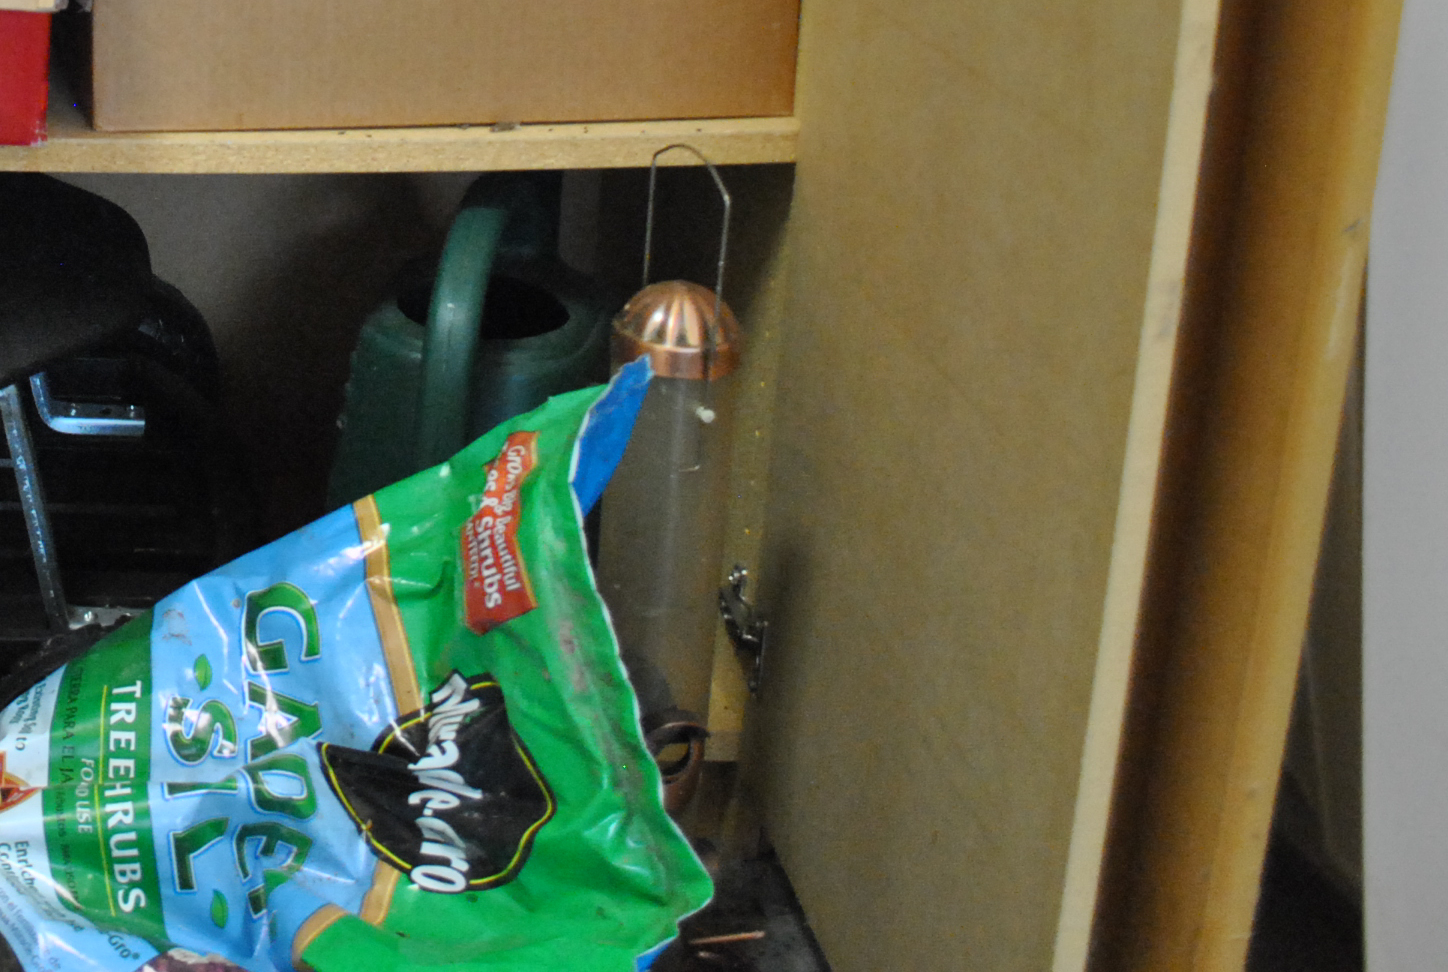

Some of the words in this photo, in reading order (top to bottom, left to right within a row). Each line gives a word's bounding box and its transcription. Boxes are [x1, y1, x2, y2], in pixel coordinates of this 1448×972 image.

[474, 515, 503, 609] Shrubs
[492, 514, 522, 592] Beautiful
[14, 736, 28, 752] to
[60, 745, 76, 763] EL
[74, 800, 93, 834] USE
